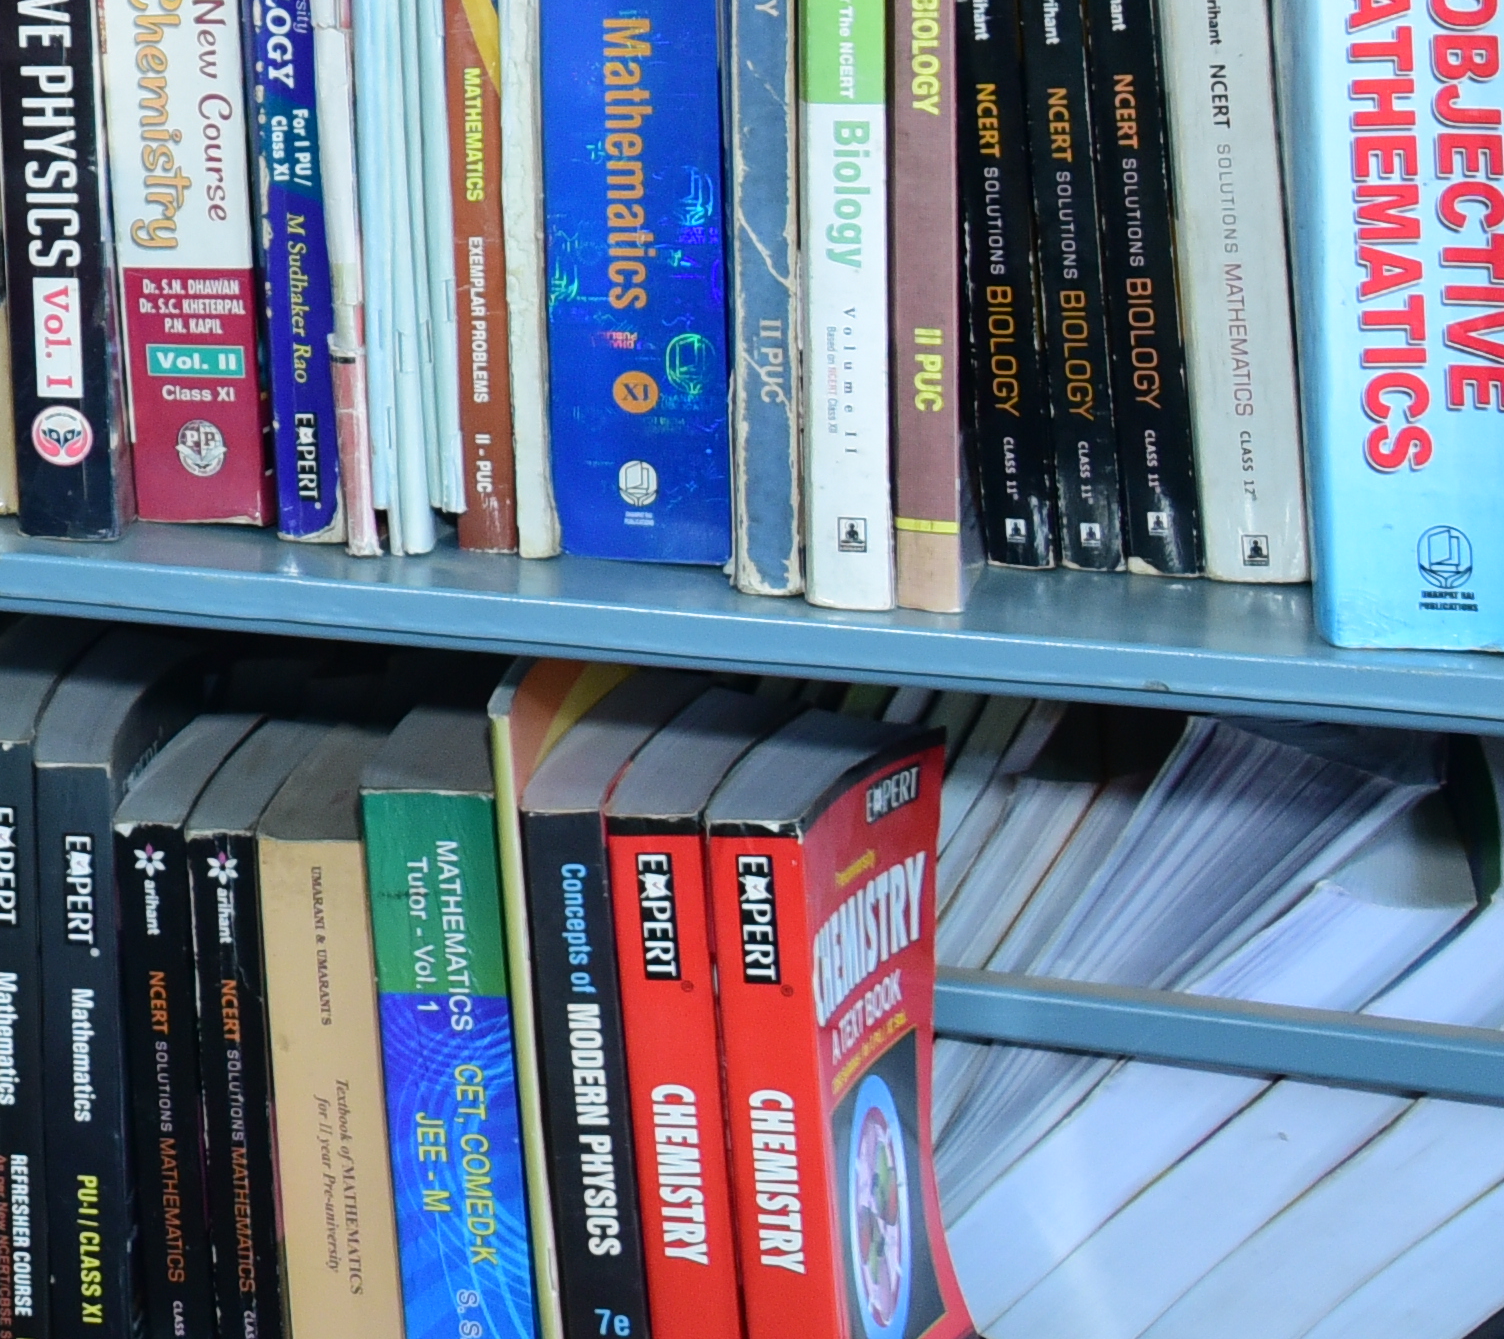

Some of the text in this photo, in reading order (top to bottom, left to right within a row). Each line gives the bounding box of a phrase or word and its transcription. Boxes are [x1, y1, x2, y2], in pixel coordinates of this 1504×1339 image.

[464, 67, 484, 202] MATHEMATICS
[838, 41, 855, 98] NCERT
[20, 65, 81, 267] PHYSICS
[197, 93, 232, 222] Course
[603, 19, 656, 309] Mathematics
[826, 120, 871, 269] Biology
[42, 286, 69, 359] Vol.
[139, 299, 245, 314] Dr. S.C. KHETERPAL
[143, 280, 239, 295] Dr. S.N. DHAWAN
[165, 319, 223, 334] P.N. KAPIL
[289, 241, 312, 384] Sudhaker Rao
[976, 83, 1020, 474] NCERT SOLUTIONS BIOLOGY CLASS
[1208, 63, 1255, 472] NCERT SOLUTIONS MATHEMATICS CLASS
[156, 351, 236, 369] Vol. II
[162, 386, 235, 401] Class XI
[469, 237, 493, 493] EXEMPLAR PROBLEMS PUC
[760, 347, 784, 403] PUC
[914, 327, 944, 412] II PUC
[311, 866, 326, 930] UMARANI
[406, 857, 428, 918] Tutor
[436, 840, 473, 1032] MATHEMATICS
[812, 851, 925, 1027] CHEMISTRY
[72, 988, 92, 1123] Mathematics
[838, 1005, 865, 1058] TEXT
[866, 969, 902, 1030] BOOK
[149, 970, 185, 1283] NCERT SOLUTIONS MATHEMATICS
[335, 1079, 363, 1296] Textbook MATHEMATICS
[415, 1113, 447, 1162] JEE
[454, 1064, 498, 1265] CET, COMED-K
[651, 1084, 709, 1265] CHEMISTRY
[749, 1089, 806, 1273] CHEMISTRY
[10, 1154, 32, 1318] REFRESHER COURSE
